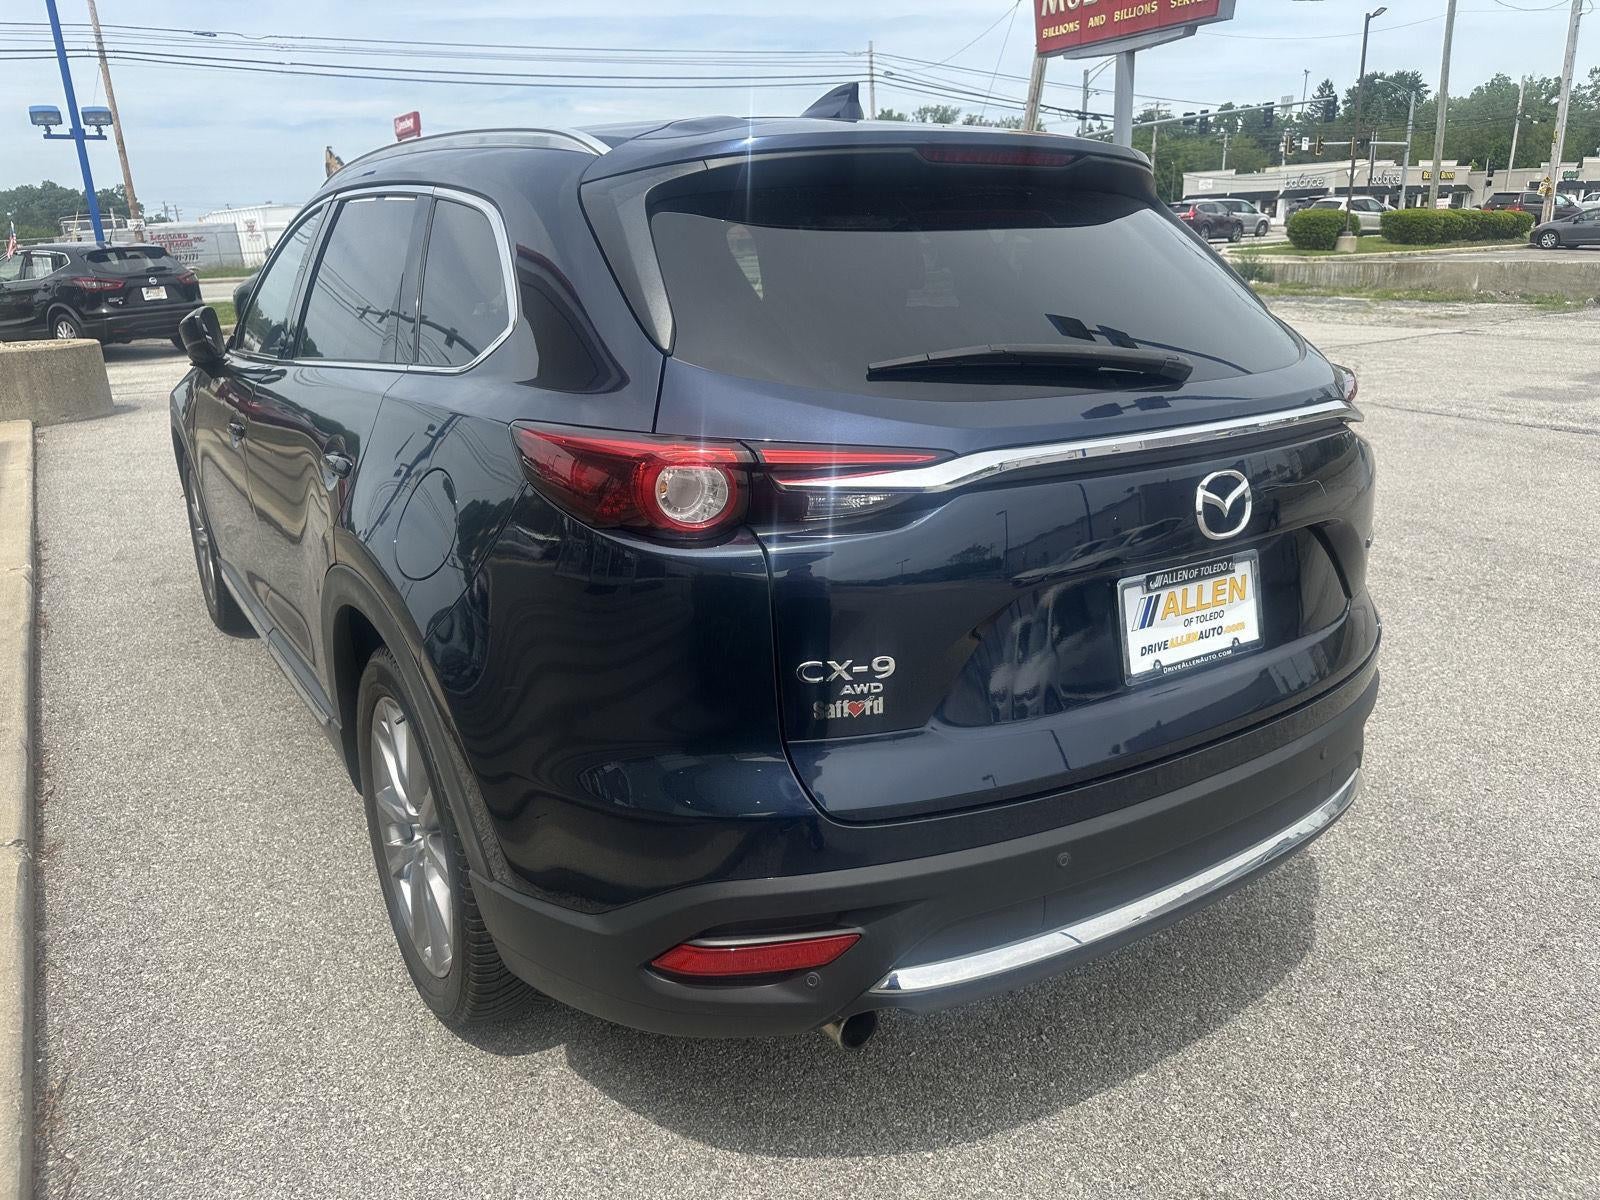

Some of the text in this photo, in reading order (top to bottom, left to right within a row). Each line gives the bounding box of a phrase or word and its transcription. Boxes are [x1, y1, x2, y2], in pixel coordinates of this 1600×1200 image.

[1042, 20, 1080, 38] BILLIONS
[1087, 14, 1106, 28] AND
[1113, 1, 1158, 22] BILLIONS
[1163, 561, 1228, 585] ALLEN OF TOLEDO
[1160, 574, 1247, 621] ALLEN
[1183, 609, 1225, 628] OF TOLEDO
[796, 655, 896, 684] CX-9
[840, 682, 884, 695] AWD
